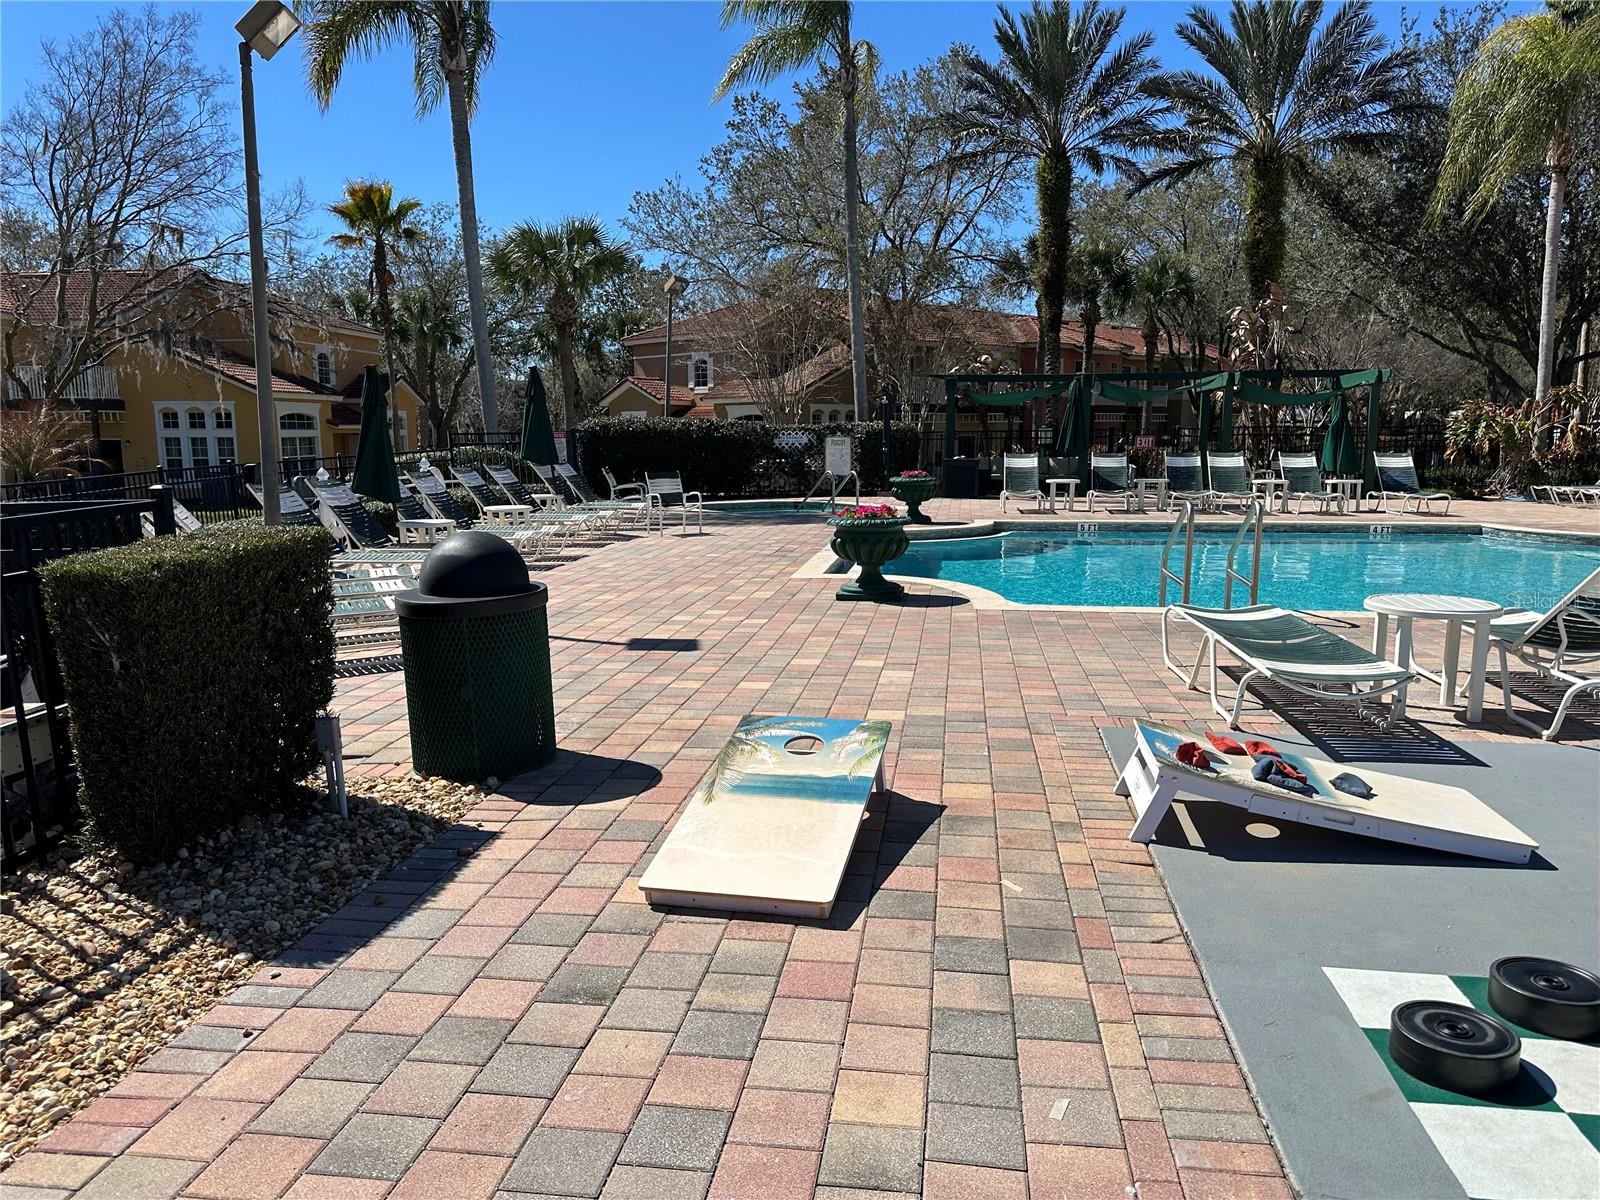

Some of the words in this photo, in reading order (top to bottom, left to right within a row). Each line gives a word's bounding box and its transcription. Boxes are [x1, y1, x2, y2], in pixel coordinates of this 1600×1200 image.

[1136, 437, 1153, 448] EXIT
[1087, 524, 1098, 532] FT
[1380, 526, 1391, 534] FT
